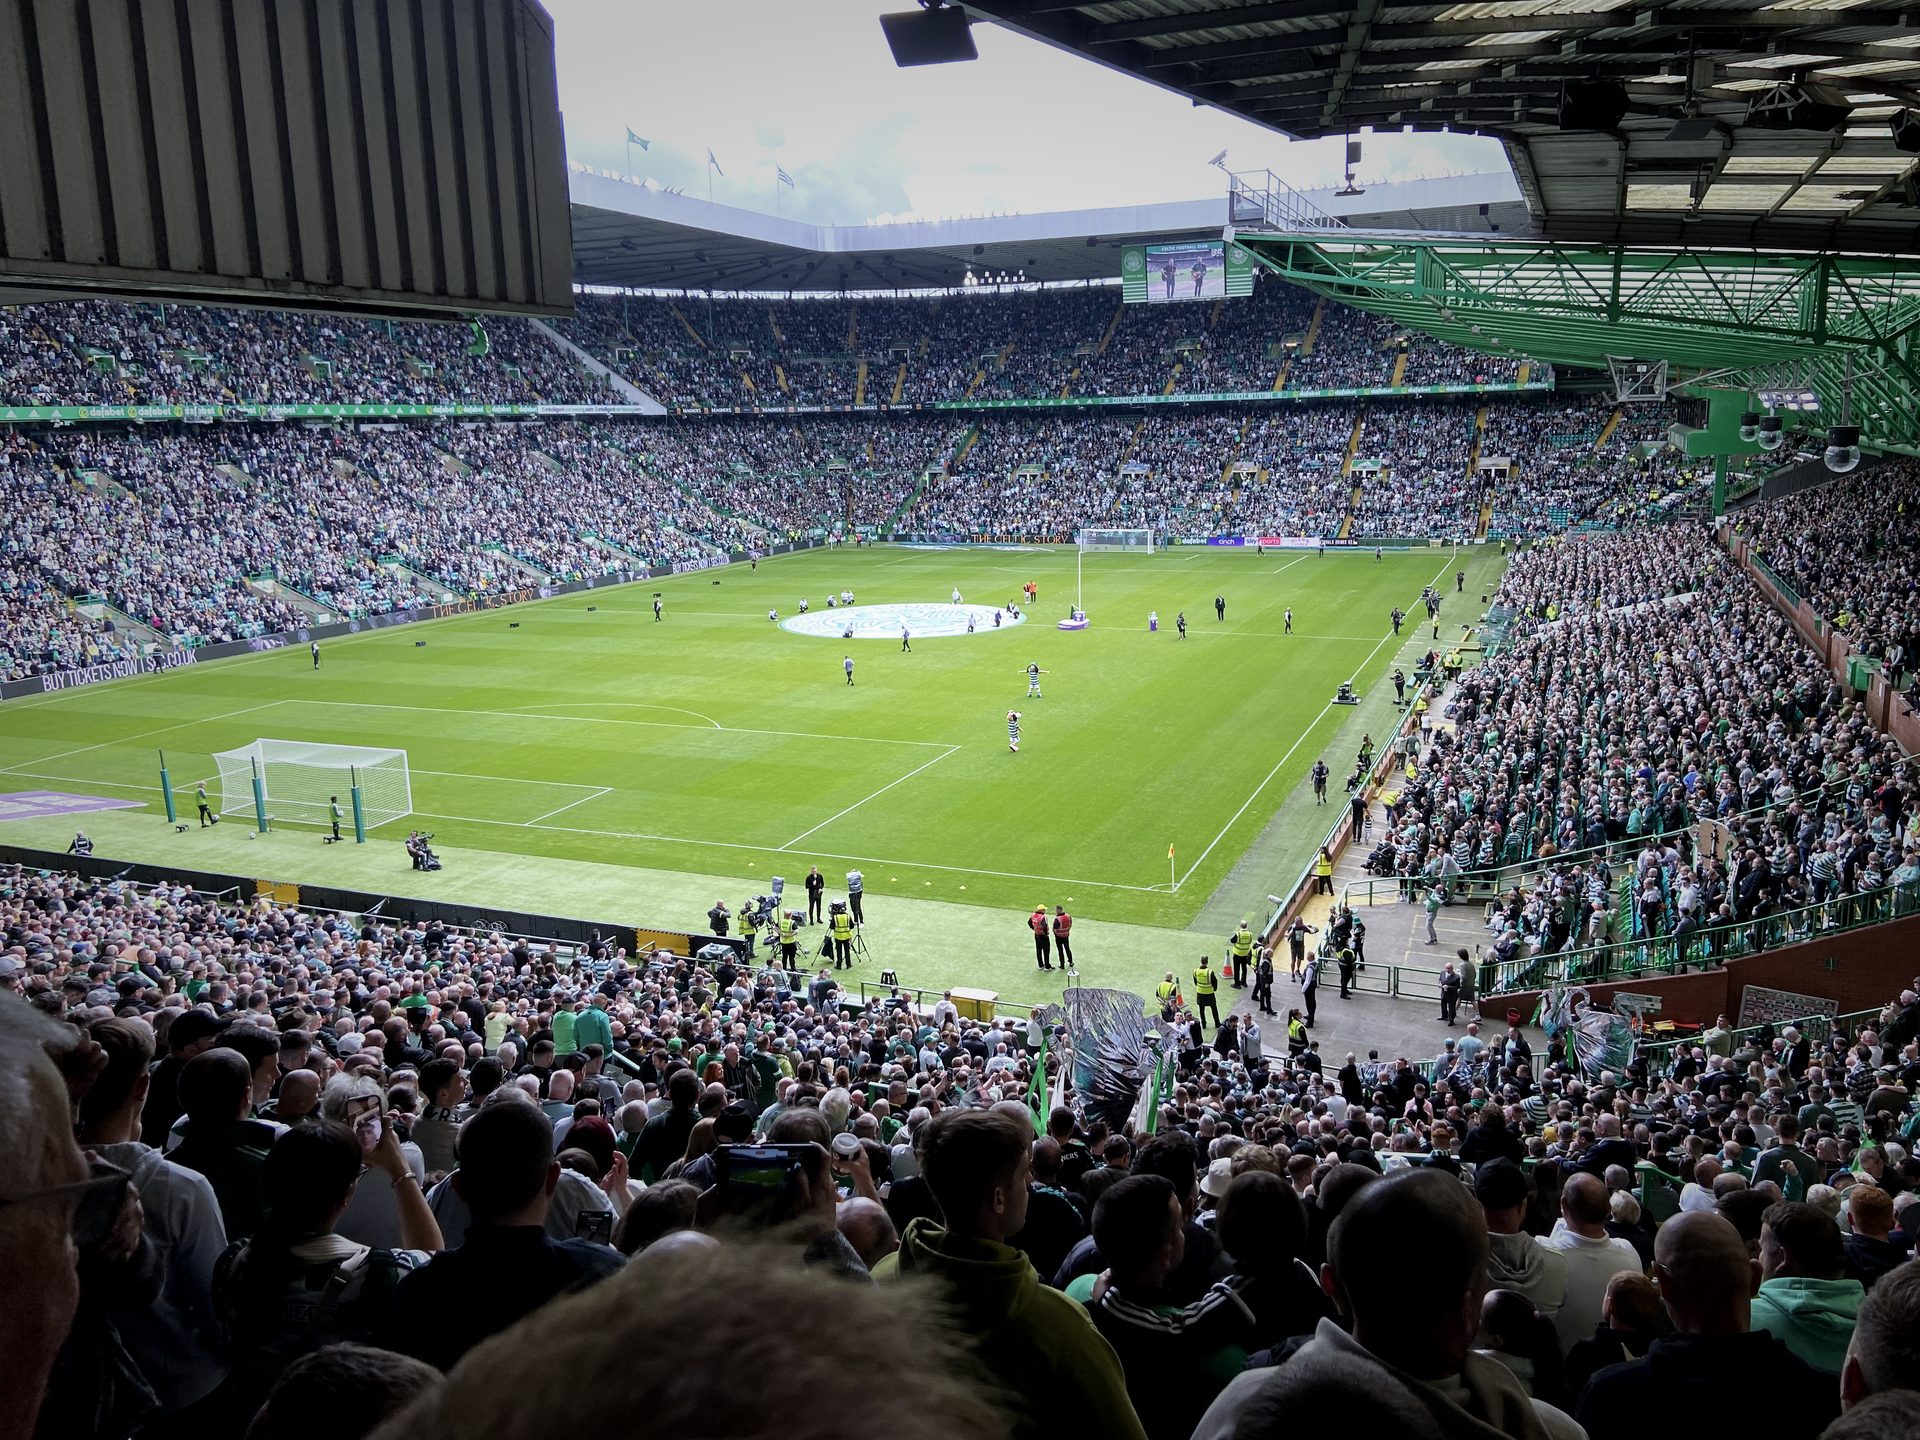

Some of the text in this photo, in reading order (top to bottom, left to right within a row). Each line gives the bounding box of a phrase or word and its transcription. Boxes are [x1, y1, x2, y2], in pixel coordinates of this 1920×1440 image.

[90, 406, 125, 418] dafabet
[137, 406, 171, 418] dafabet
[971, 534, 1069, 544] THE CELTIC STORY
[431, 603, 455, 618] THE
[500, 589, 534, 606] STORY
[42, 671, 65, 692] BUY
[67, 663, 112, 688] TICKETS
[112, 659, 138, 679] NOW
